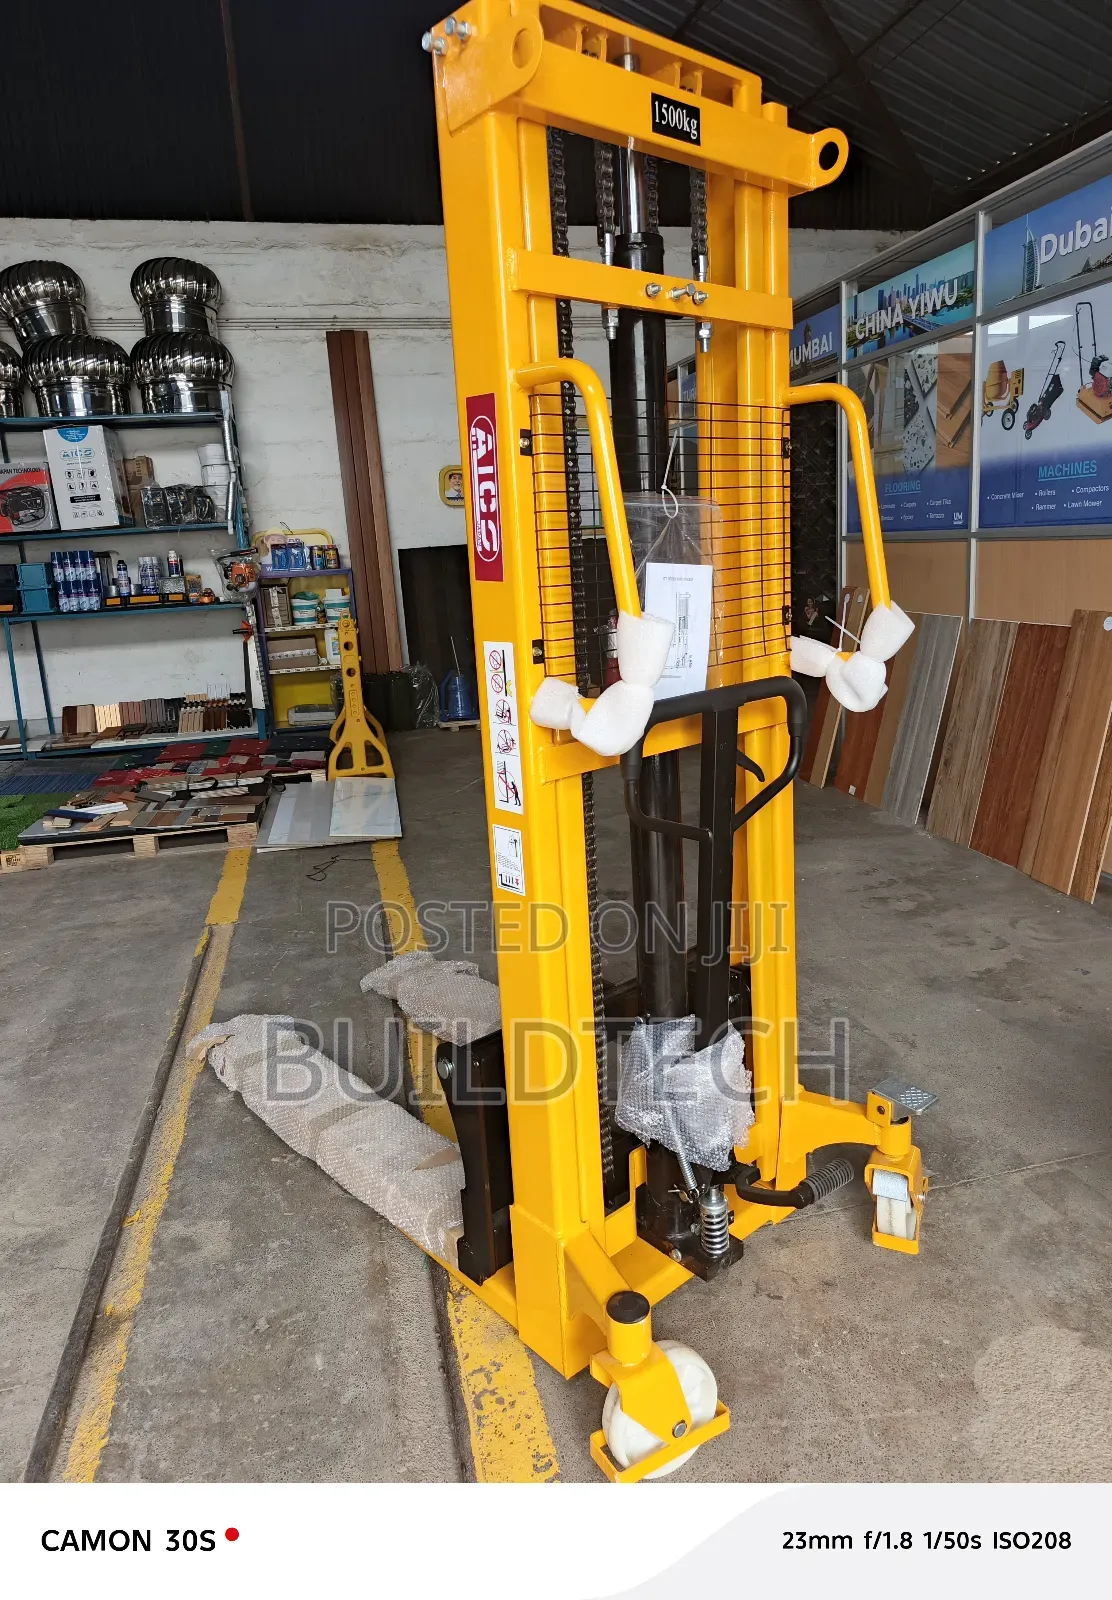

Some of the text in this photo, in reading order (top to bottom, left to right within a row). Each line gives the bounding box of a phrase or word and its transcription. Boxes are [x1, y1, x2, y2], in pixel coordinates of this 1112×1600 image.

[655, 101, 698, 139] 1500kg
[855, 278, 958, 340] CHINA YIWU
[1038, 460, 1098, 479] MACHINES
[884, 480, 922, 494] FLOORING
[1075, 484, 1110, 494] Compactors
[990, 493, 1011, 501] Concrete
[1038, 489, 1056, 497] Rollers
[1035, 503, 1057, 511] Rammer
[1067, 499, 1103, 509] Lawn Mower
